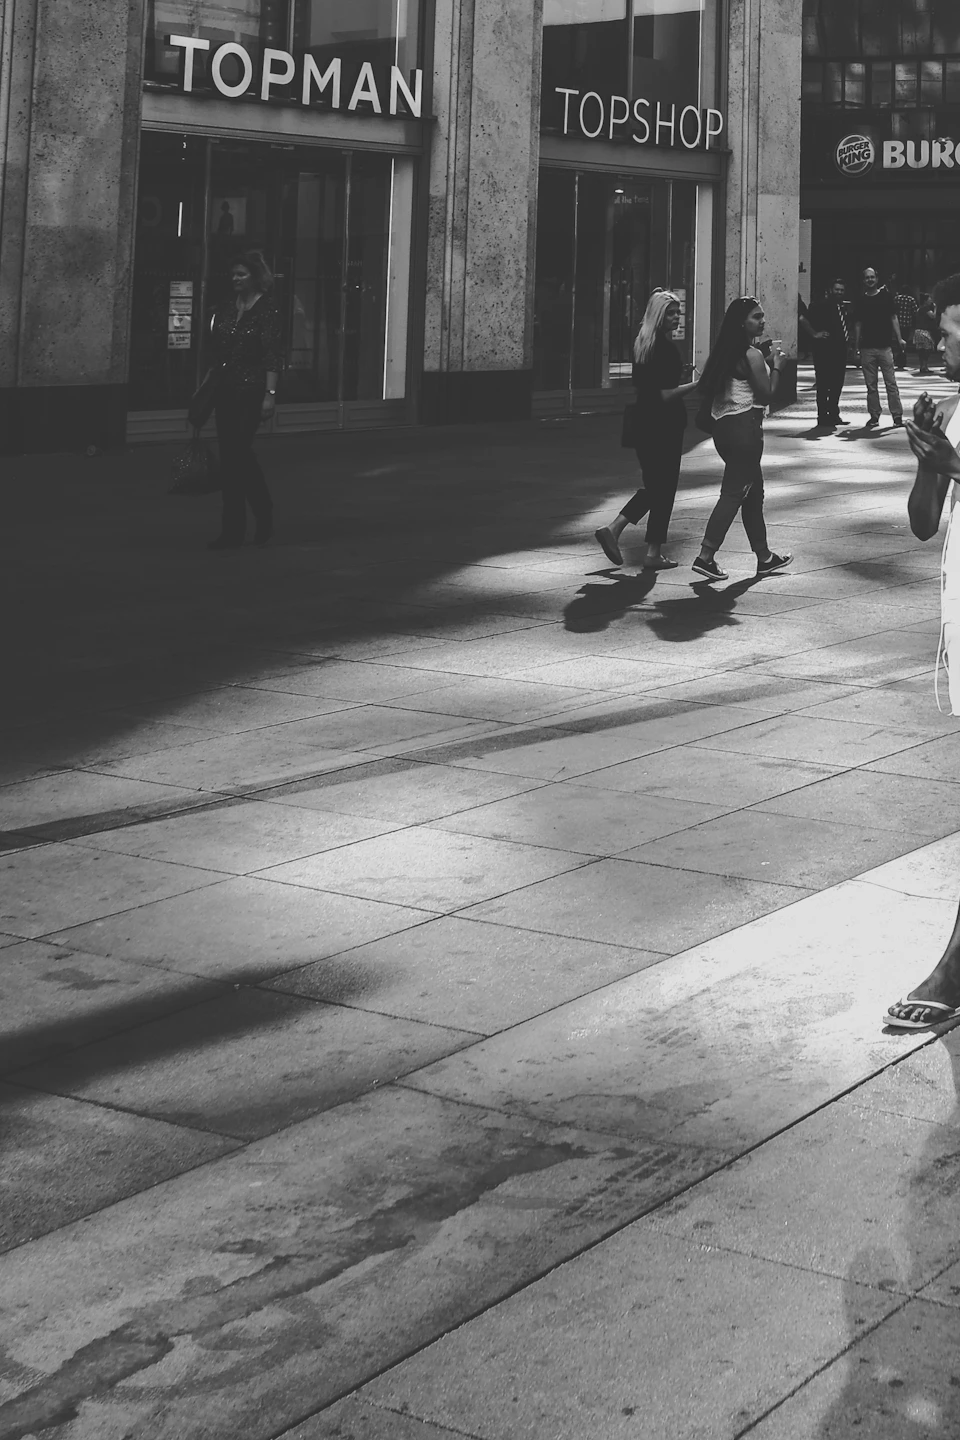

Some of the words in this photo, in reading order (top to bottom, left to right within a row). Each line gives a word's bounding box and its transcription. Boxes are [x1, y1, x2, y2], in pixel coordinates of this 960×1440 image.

[167, 34, 423, 118] TOPMAN
[555, 87, 723, 150] TOPSHOP
[838, 141, 870, 158] BURGER
[839, 149, 871, 168] KING
